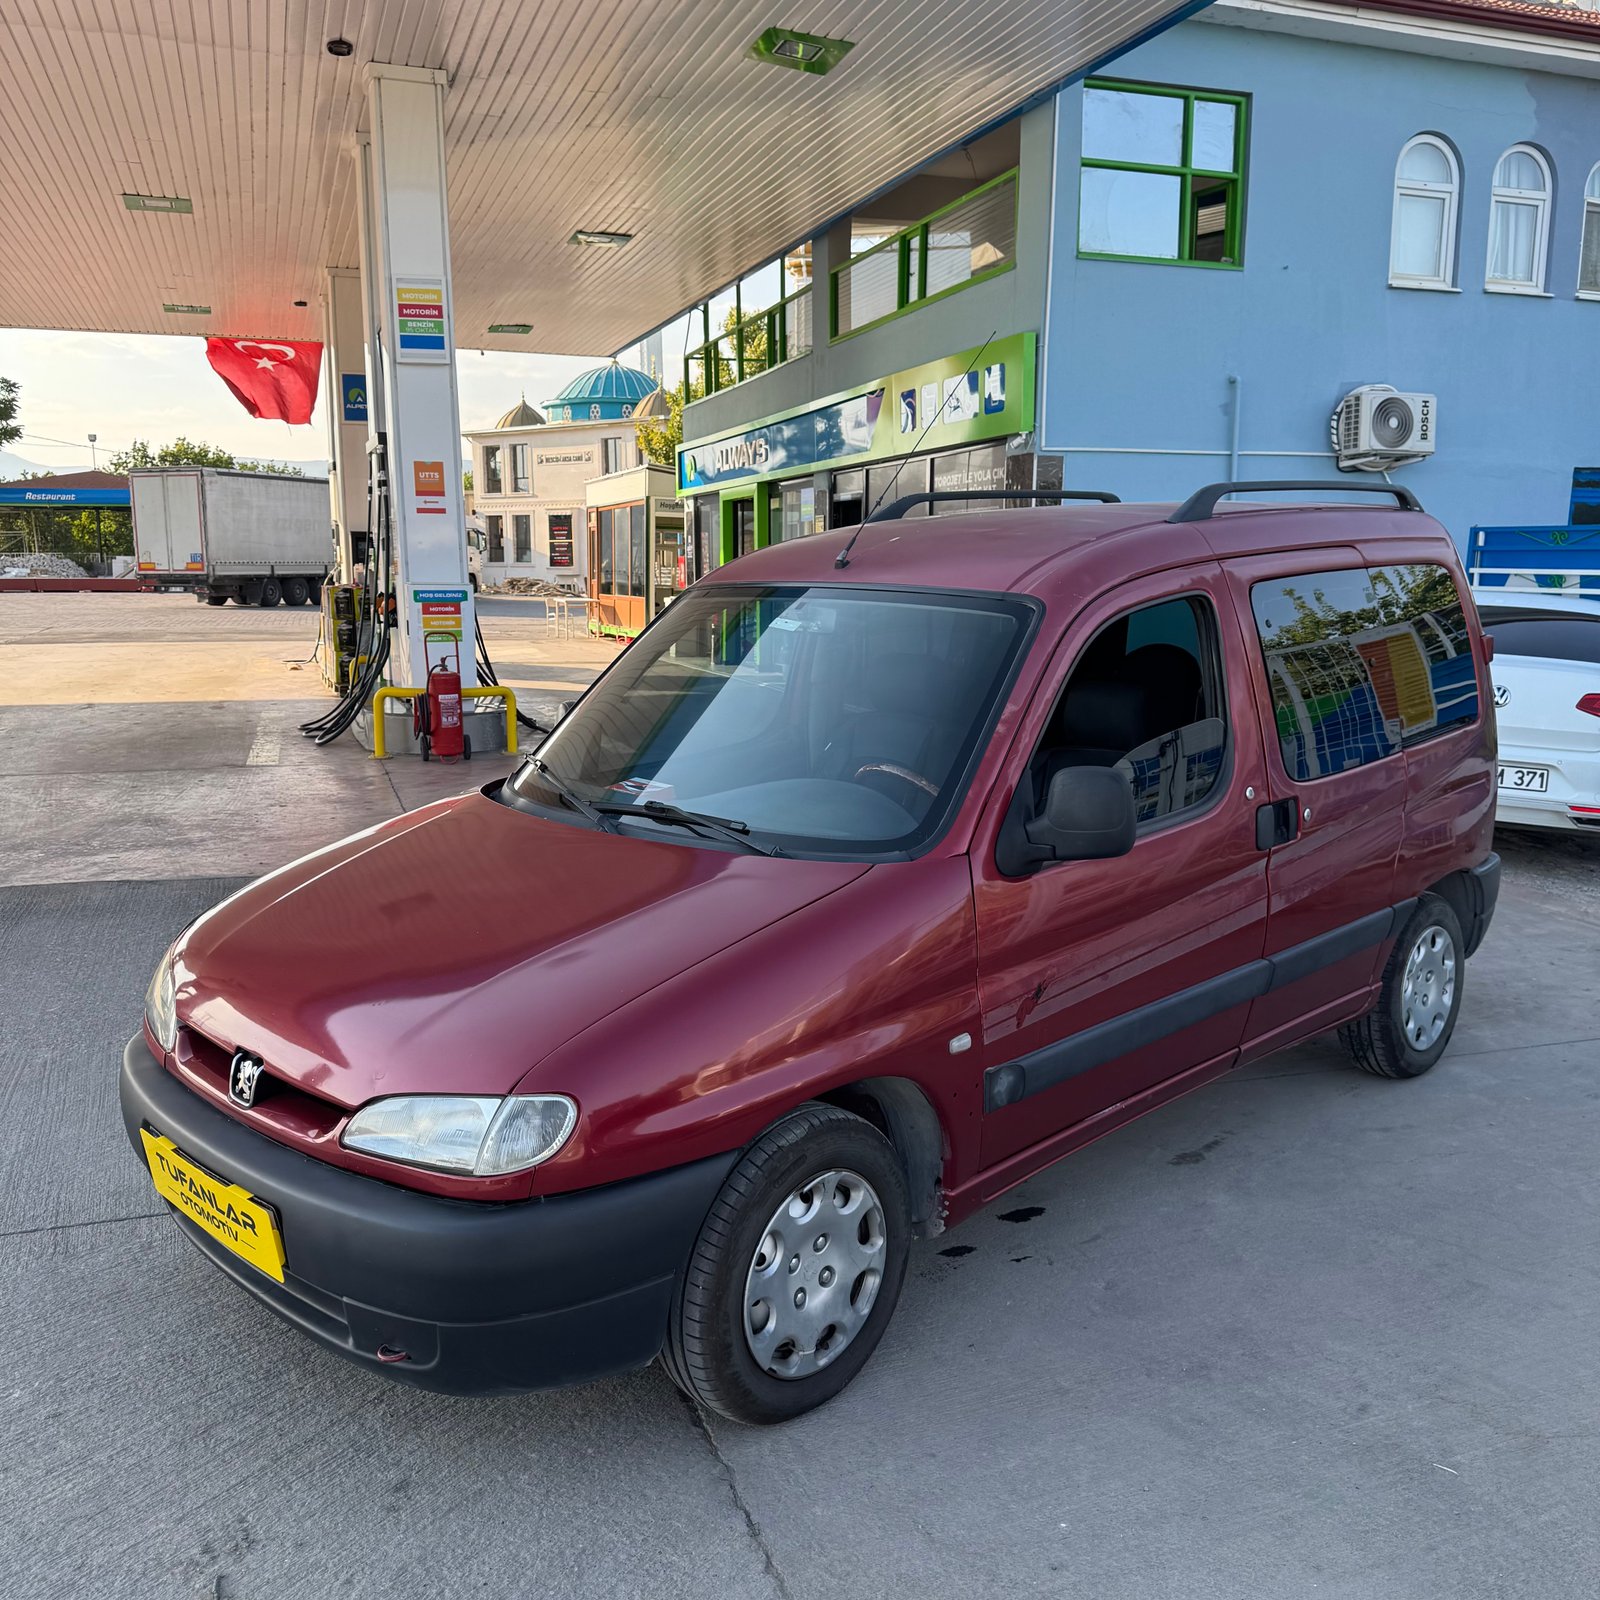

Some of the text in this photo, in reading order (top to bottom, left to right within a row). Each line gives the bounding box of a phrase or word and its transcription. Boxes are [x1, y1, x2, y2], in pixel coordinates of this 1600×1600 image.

[407, 320, 434, 328] BENZİN
[1420, 400, 1430, 440] BOSCH
[716, 438, 769, 472] ALWAYS
[419, 471, 440, 479] UTTS
[973, 469, 991, 483] YOLA
[25, 491, 76, 501] Restaurant
[1513, 769, 1545, 789] 371
[155, 1151, 259, 1237] TUFANLAR
[180, 1191, 238, 1242] OTOMOTİV
